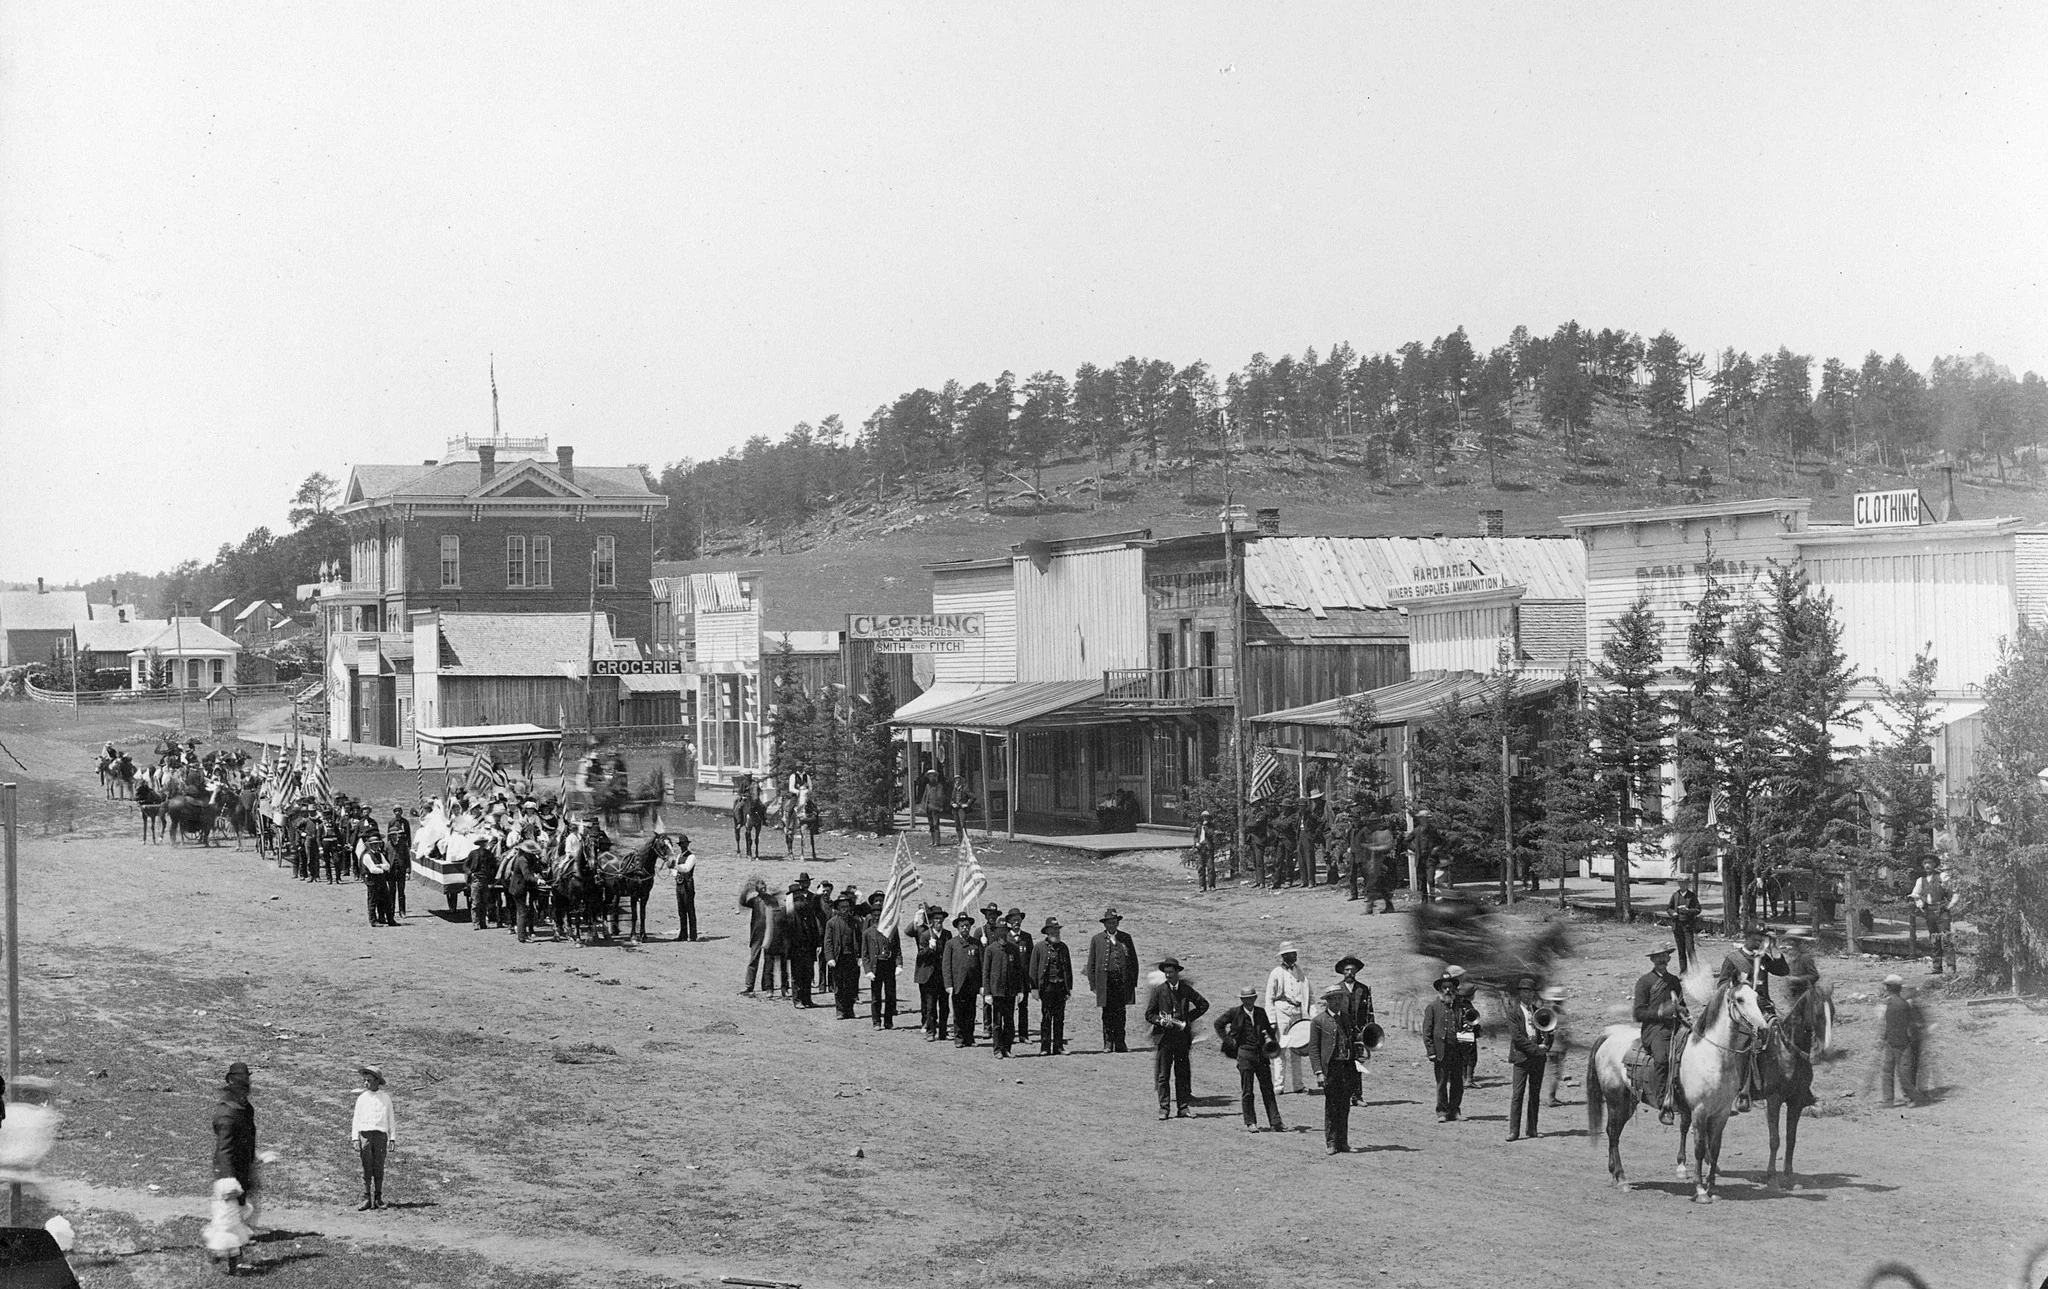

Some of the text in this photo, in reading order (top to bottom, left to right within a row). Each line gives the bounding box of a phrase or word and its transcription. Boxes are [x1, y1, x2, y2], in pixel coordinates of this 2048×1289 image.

[1857, 492, 1917, 524] CLOTHING
[1388, 586, 1413, 600] MINERS
[854, 615, 980, 635] CLOTHING
[876, 642, 906, 652] SMITH
[929, 641, 960, 652] FITCH
[596, 661, 679, 674] GROCERIE
